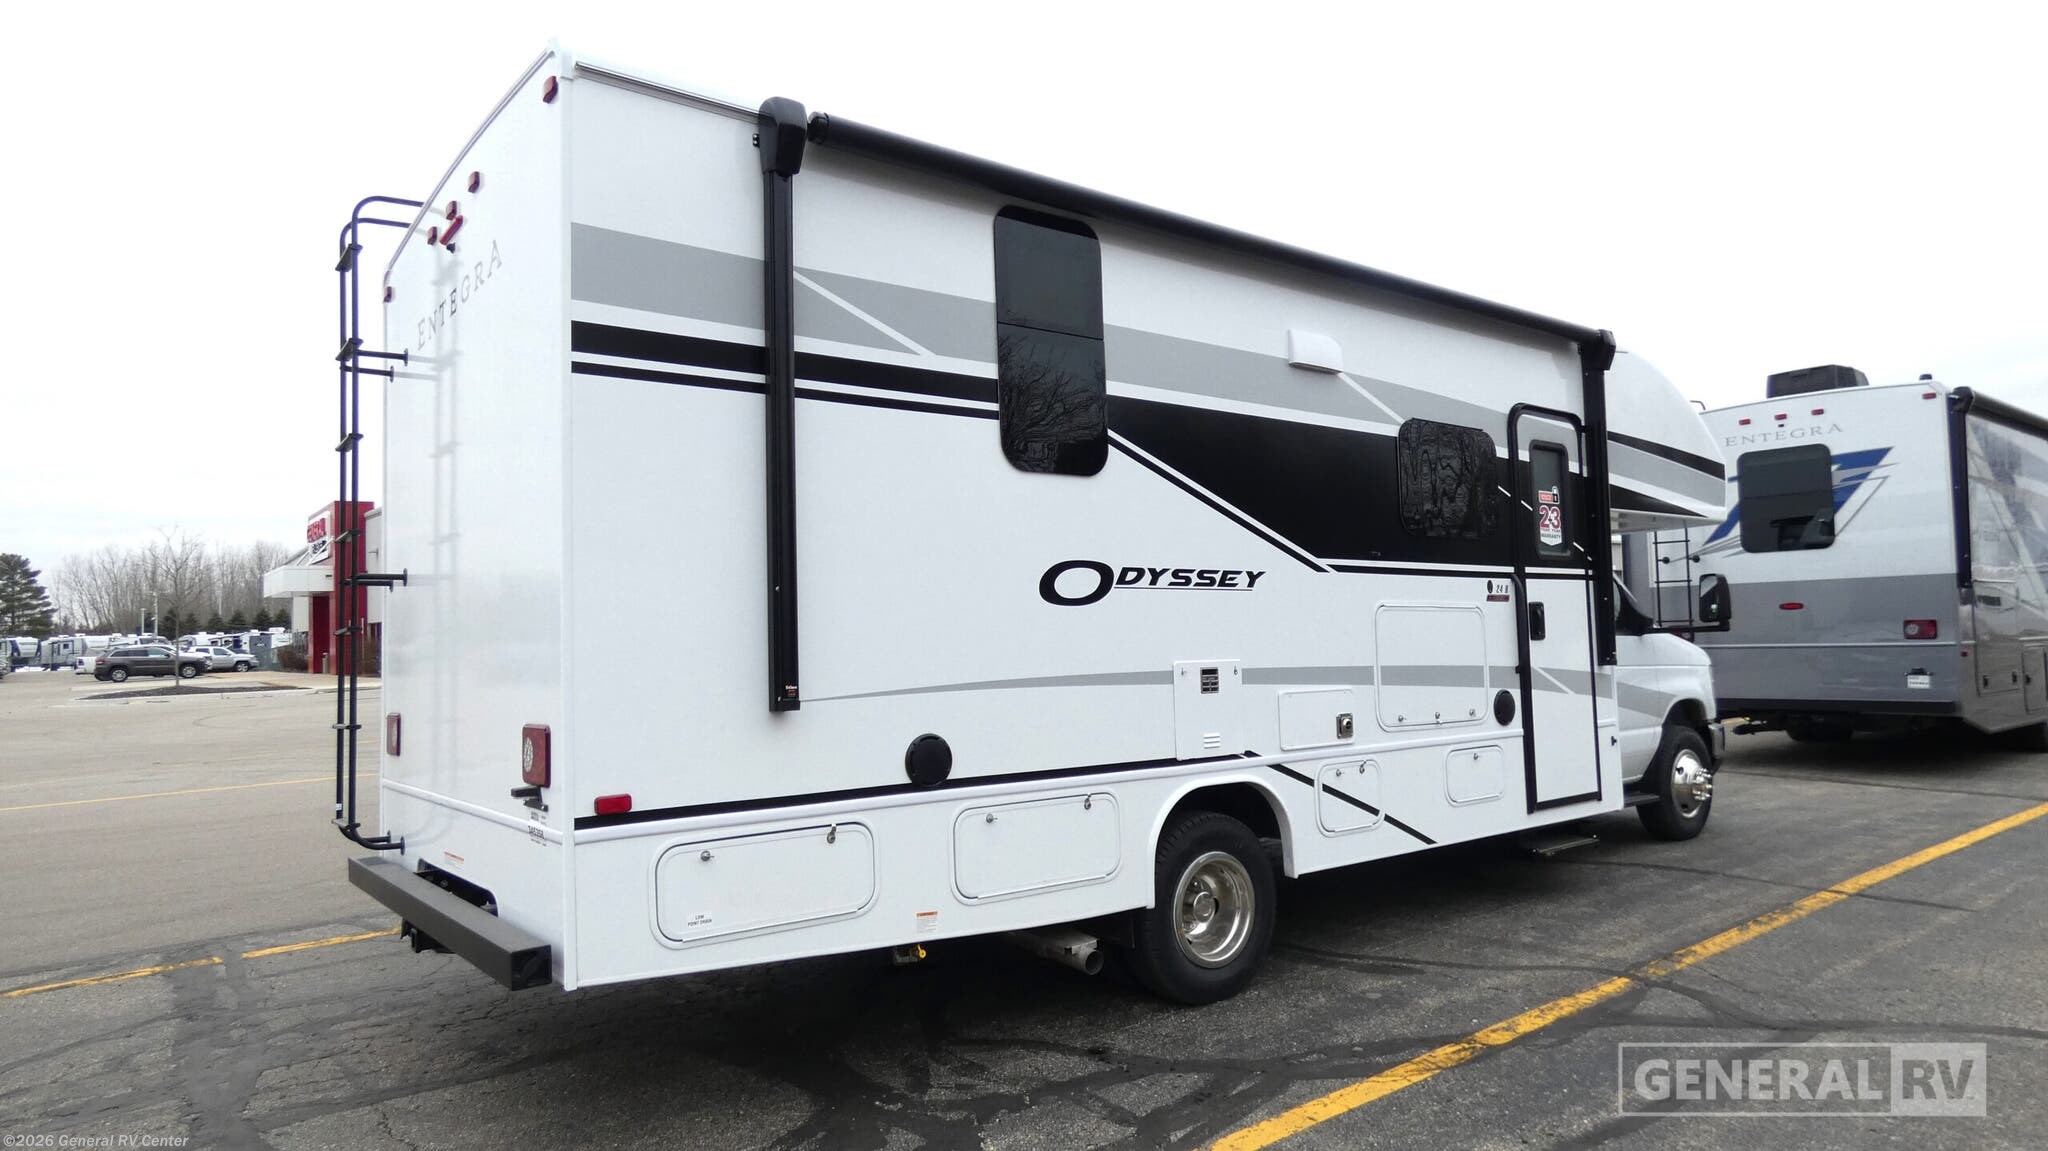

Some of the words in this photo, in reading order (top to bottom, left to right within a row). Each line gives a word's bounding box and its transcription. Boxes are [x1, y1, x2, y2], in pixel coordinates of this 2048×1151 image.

[418, 239, 502, 351] ENTEGRA
[1725, 423, 1843, 447] ENTEGRA
[1039, 560, 1266, 606] ODYSSEY
